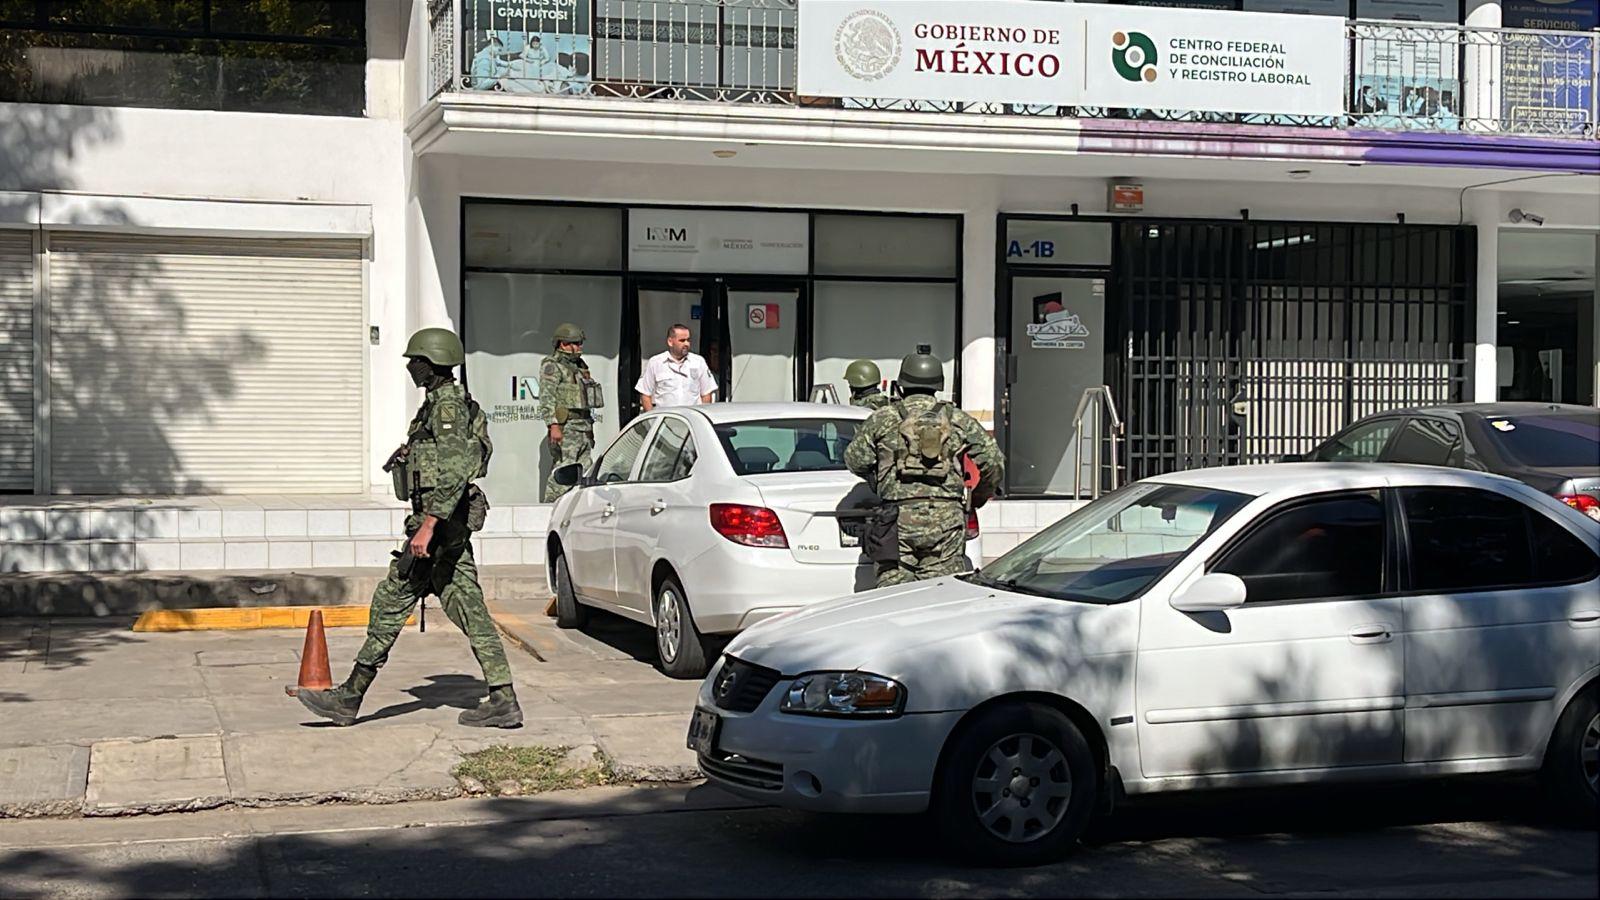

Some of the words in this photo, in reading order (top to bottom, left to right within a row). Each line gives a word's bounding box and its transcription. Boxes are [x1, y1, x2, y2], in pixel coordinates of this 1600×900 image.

[498, 8, 568, 20] GRATUITOS!
[915, 23, 1026, 43] GOBIERNO
[1032, 29, 1060, 44] DE
[1170, 38, 1223, 51] CENTRO
[1227, 41, 1286, 54] FEDERAL
[915, 42, 1060, 77] MÉXICO
[1170, 53, 1187, 64] DE
[1191, 54, 1284, 69] CONCILIACIÓN
[1169, 69, 1178, 79] Y
[1182, 69, 1247, 82] REGISTRO
[1251, 72, 1311, 85] LABORAL
[1007, 240, 1054, 257] A-1B
